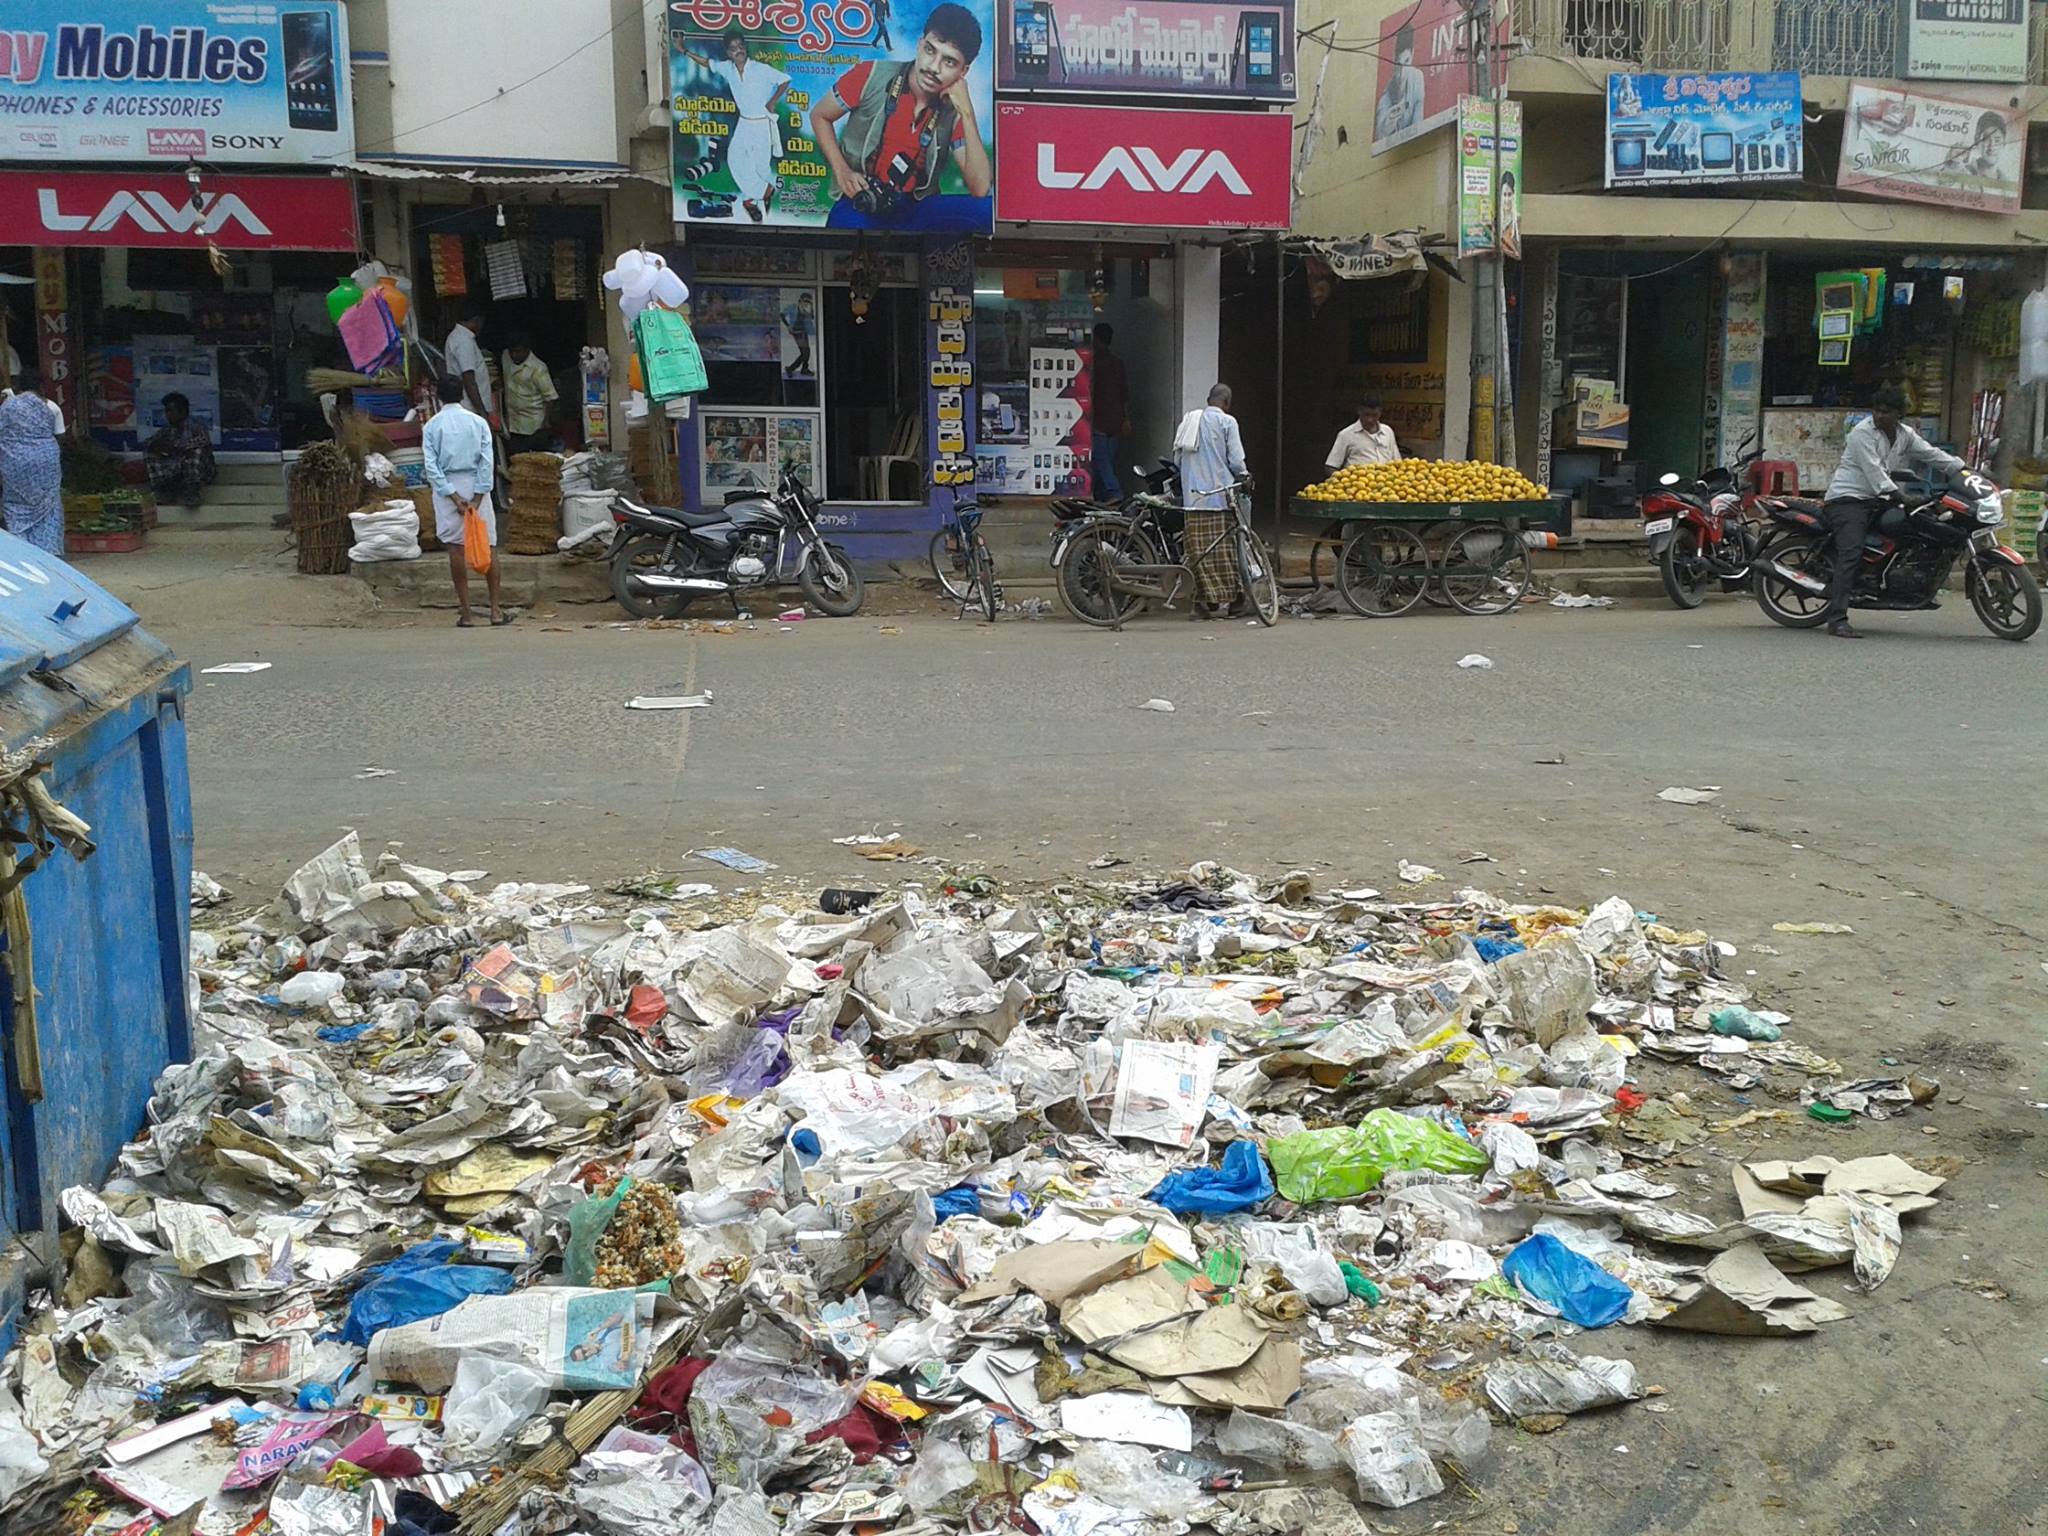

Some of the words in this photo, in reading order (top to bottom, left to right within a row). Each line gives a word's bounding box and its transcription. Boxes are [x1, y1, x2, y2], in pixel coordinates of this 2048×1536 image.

[1946, 4, 2003, 20] UNION
[56, 25, 267, 83] Mobiles
[83, 96, 98, 115] &
[103, 97, 223, 117] ACCESSORIES
[149, 129, 203, 146] LAVA
[211, 135, 286, 150] SONY
[1037, 143, 1253, 195] LAVA
[37, 188, 273, 235] LAVA
